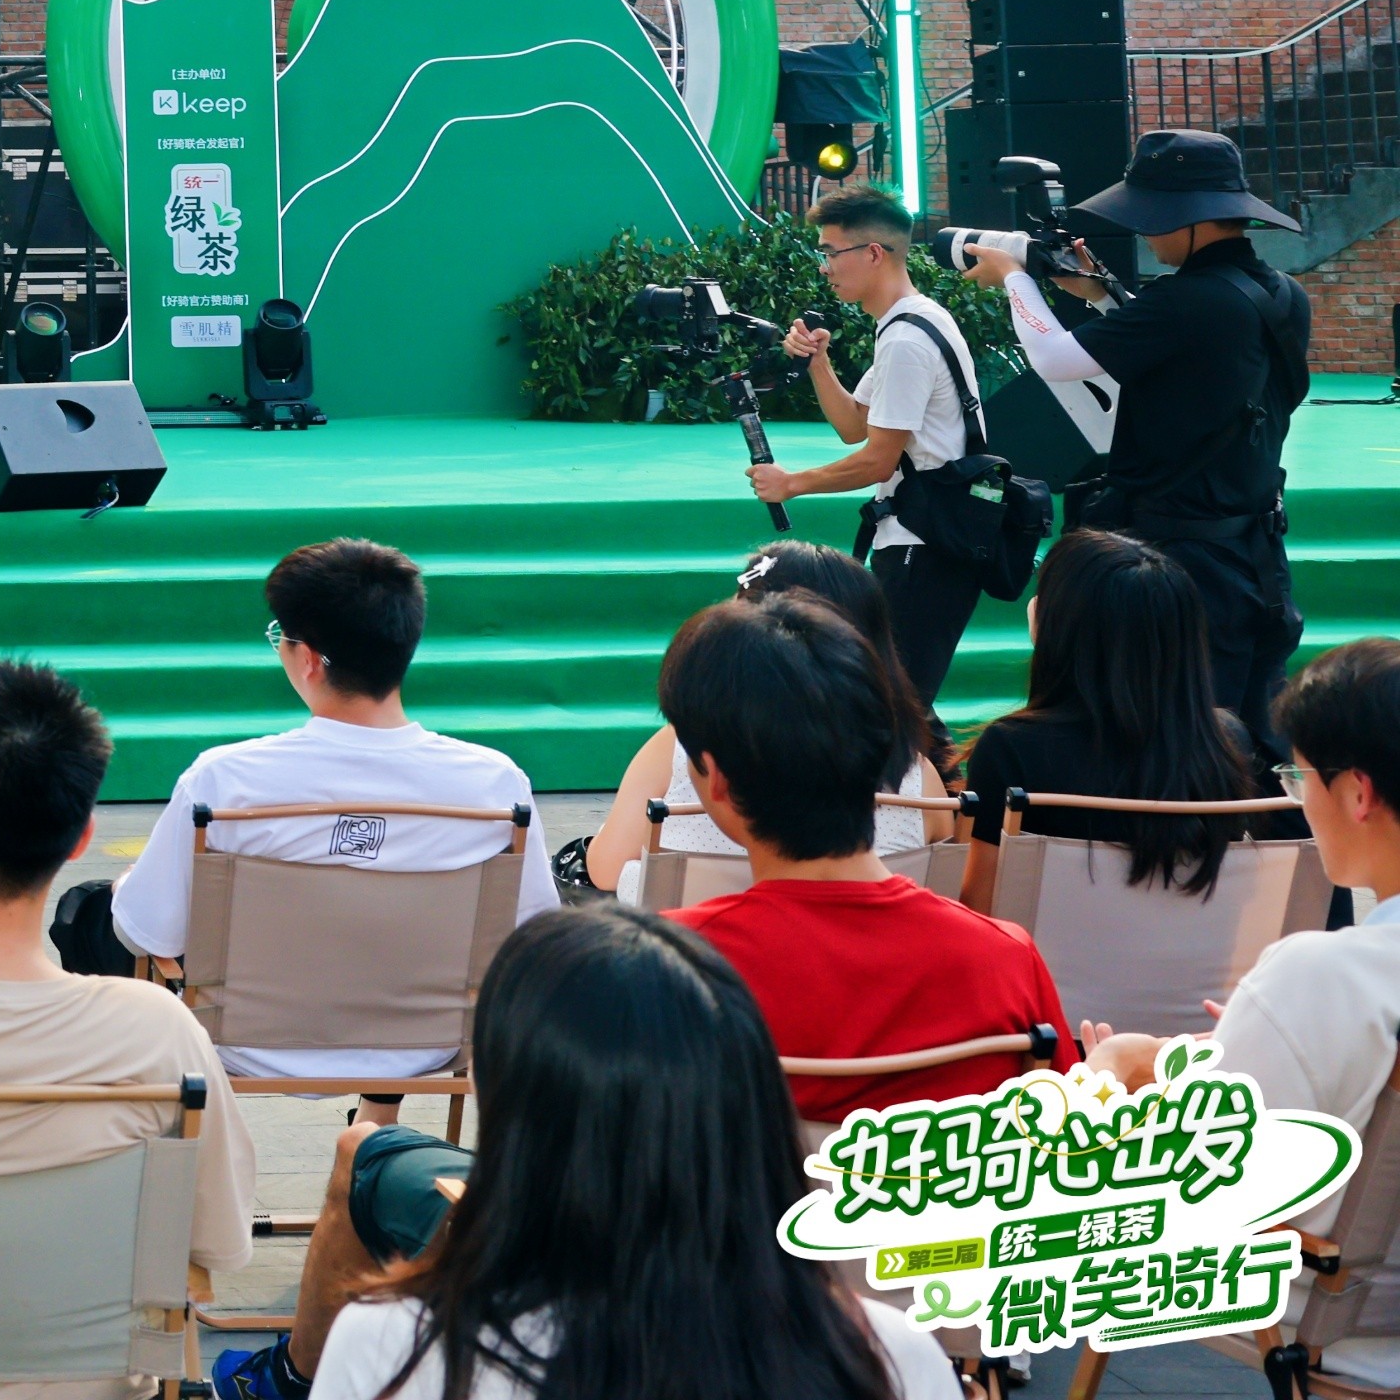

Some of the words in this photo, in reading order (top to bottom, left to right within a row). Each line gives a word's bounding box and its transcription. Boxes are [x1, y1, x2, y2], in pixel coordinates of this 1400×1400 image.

[183, 92, 247, 119] keep
[184, 176, 219, 189] 统一
[170, 195, 234, 271] 绿茶
[179, 321, 233, 337] 雪肌精
